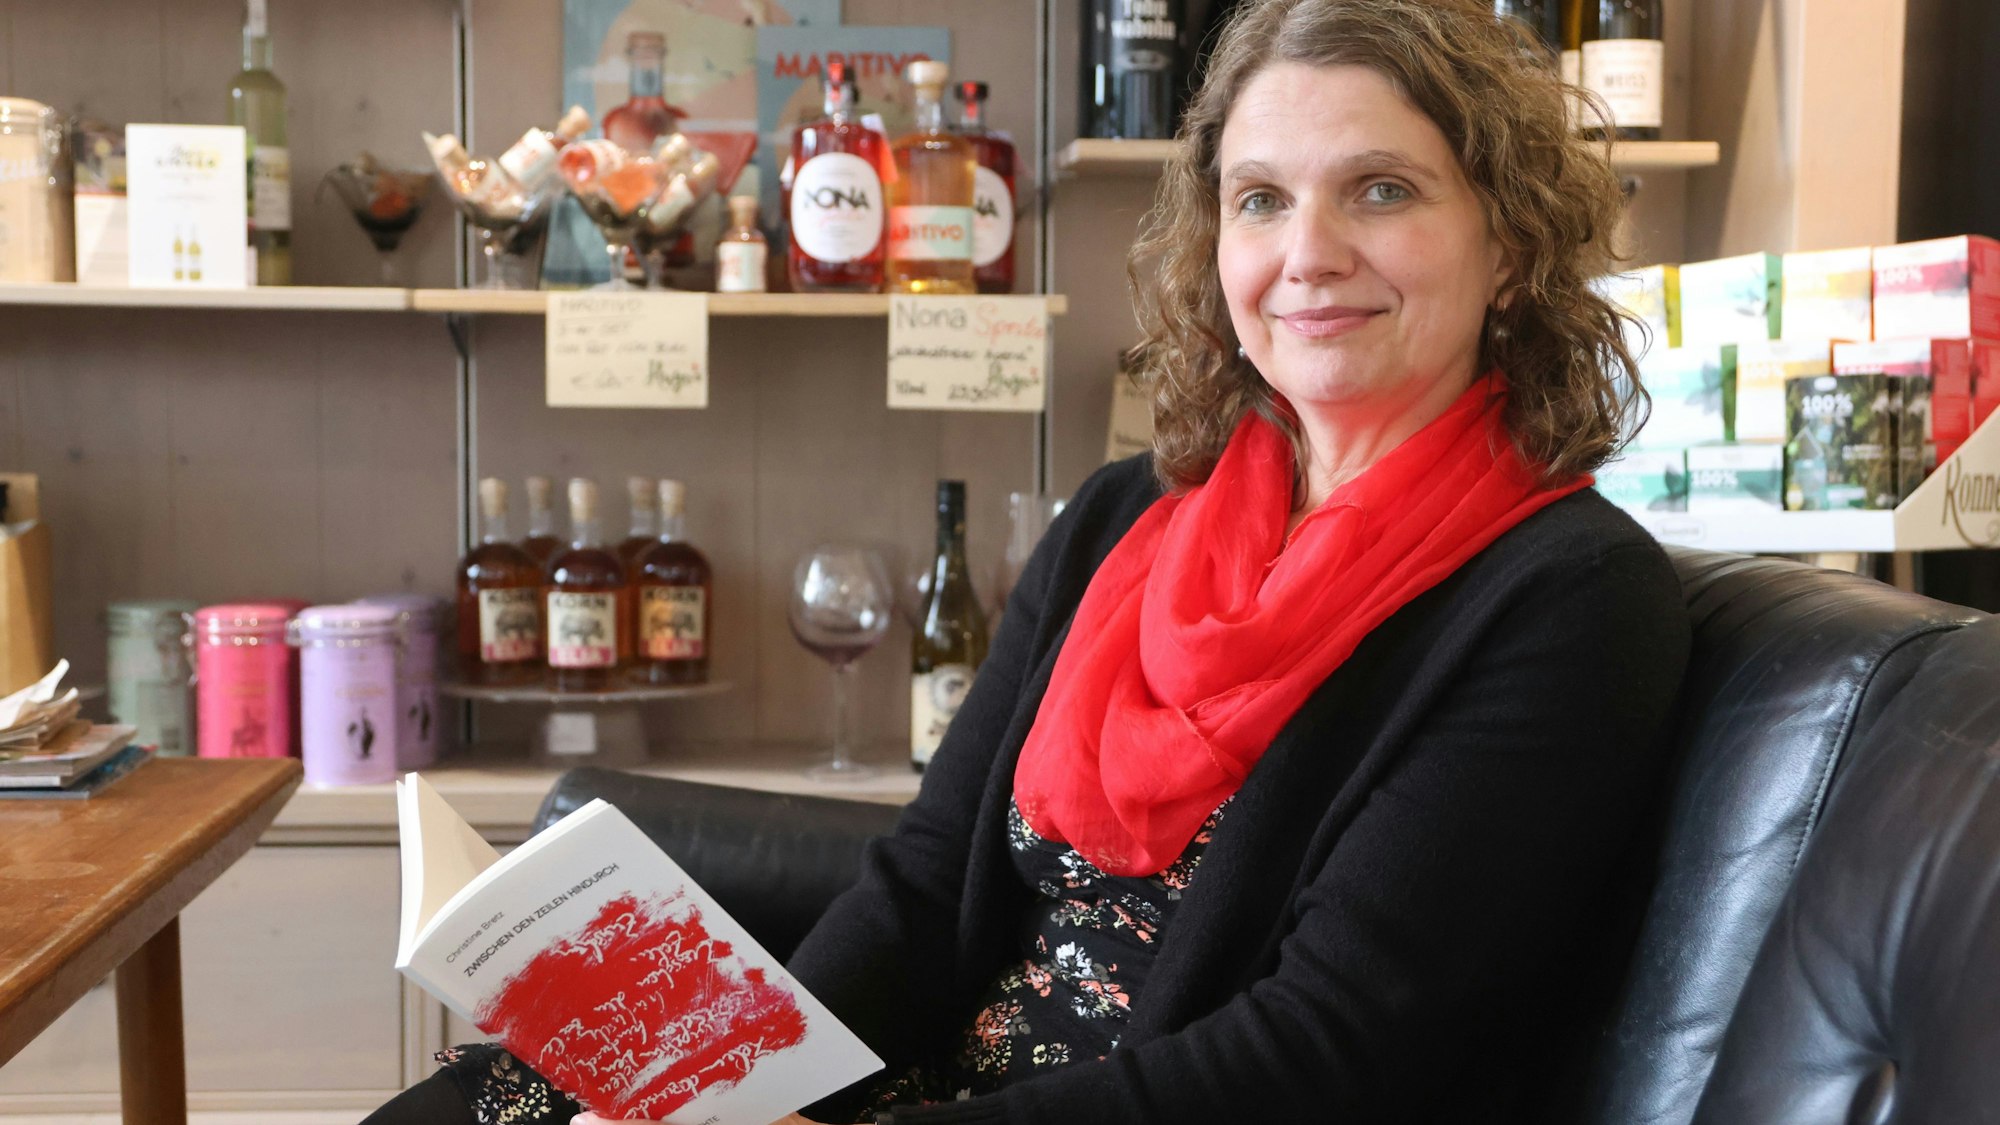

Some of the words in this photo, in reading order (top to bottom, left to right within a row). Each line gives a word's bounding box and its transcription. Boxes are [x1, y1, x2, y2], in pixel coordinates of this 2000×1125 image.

[896, 300, 968, 330] Nona
[1802, 393, 1853, 418] 100%
[1691, 470, 1738, 489] 100%
[464, 931, 515, 977] ZWISCHEN
[512, 915, 536, 935] DEN
[534, 893, 569, 919] ZEILEN
[567, 862, 620, 898] HINDURCH
[446, 930, 482, 963] Christine
[480, 910, 505, 931] Bretz
